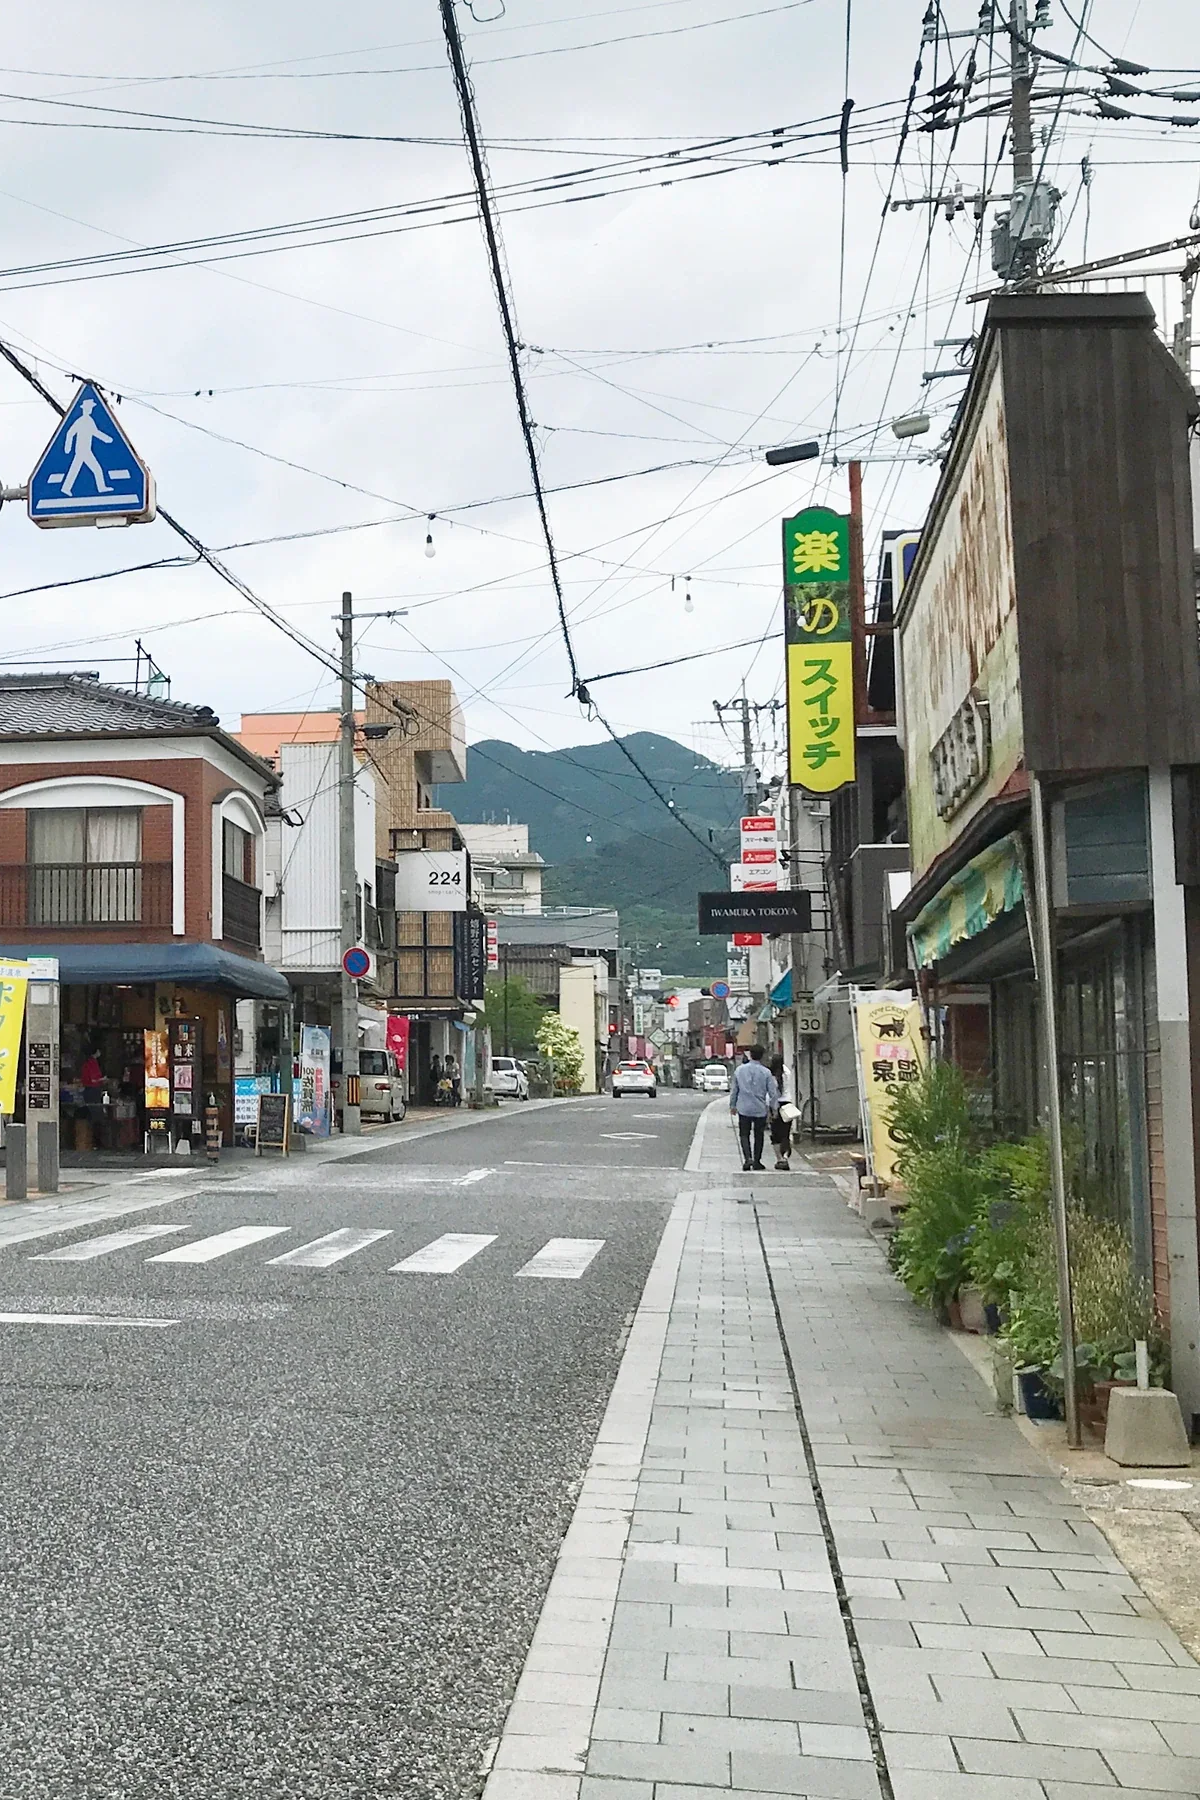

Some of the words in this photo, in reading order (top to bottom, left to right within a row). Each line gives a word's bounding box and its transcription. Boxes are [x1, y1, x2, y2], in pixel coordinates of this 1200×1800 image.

[793, 530, 841, 770] 楽のスイッチ
[428, 870, 462, 885] 224
[711, 908, 755, 917] IWAMURA
[759, 908, 798, 916] TOKOYA
[800, 1018, 820, 1030] 30
